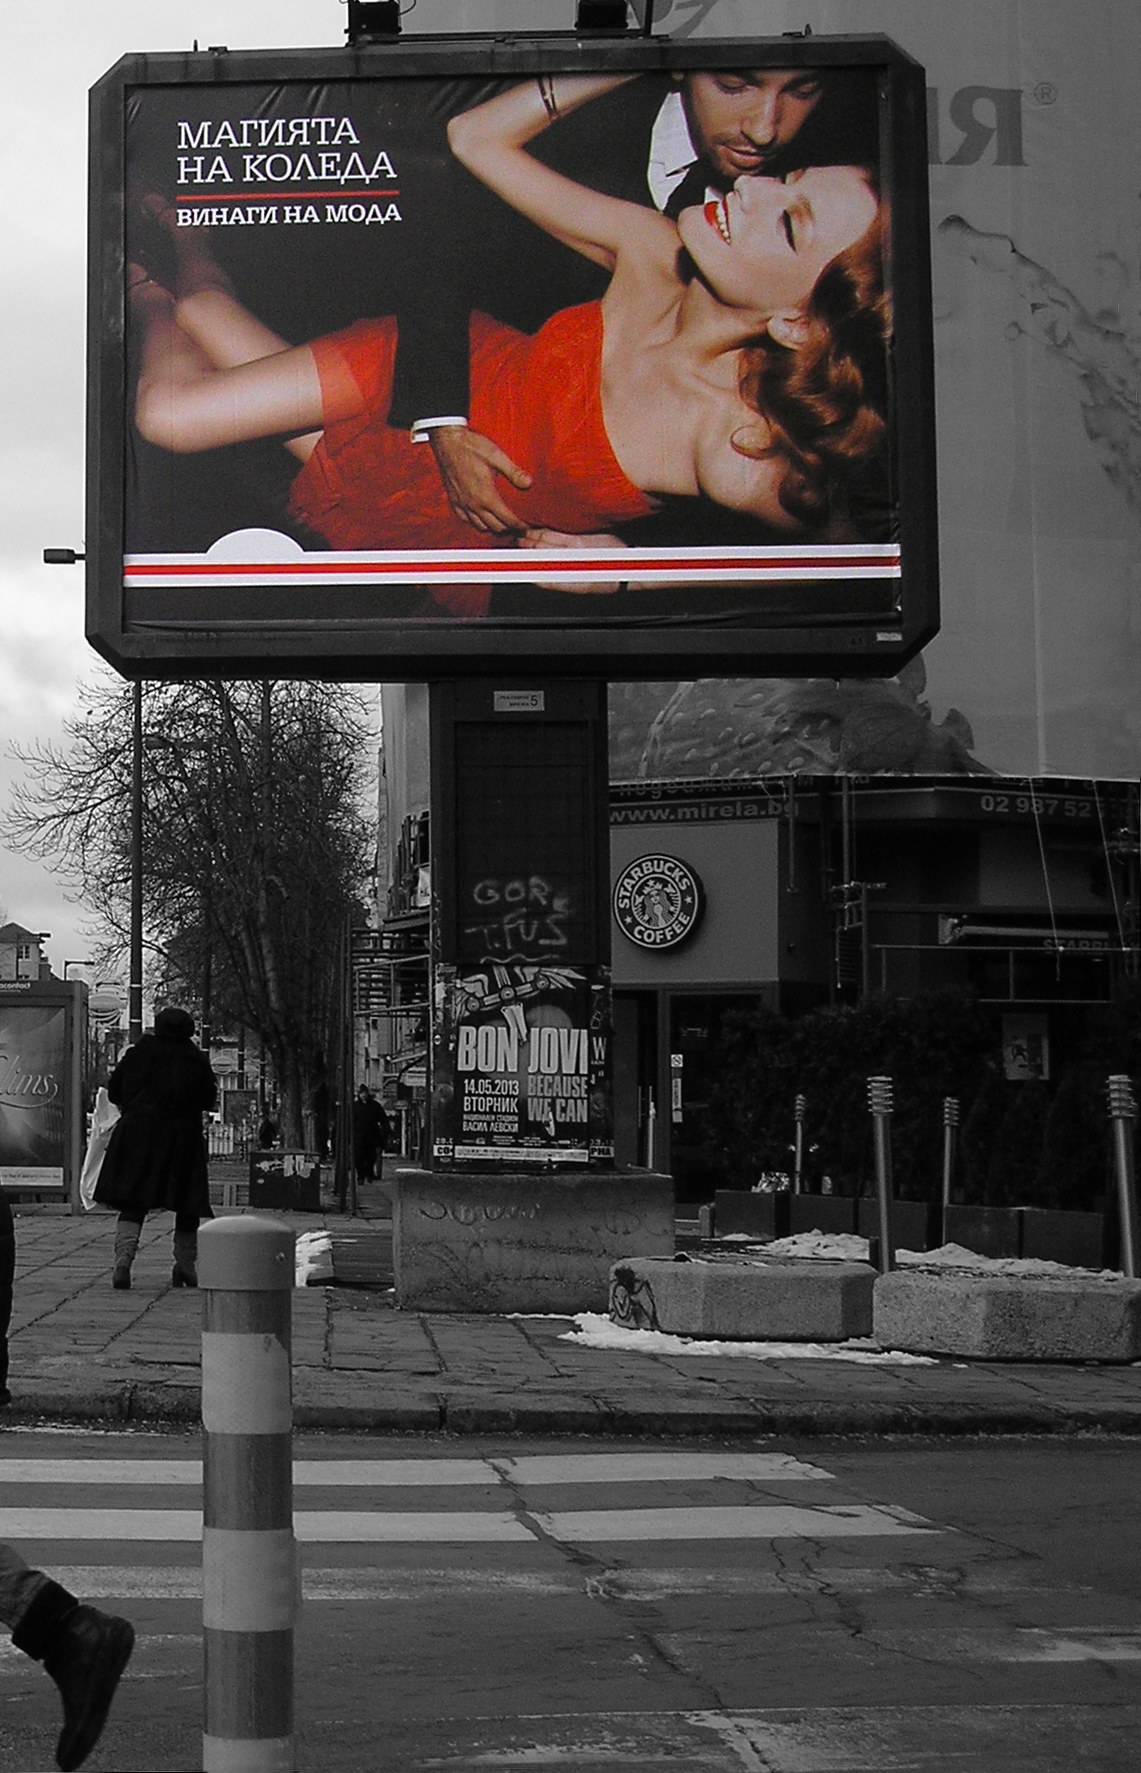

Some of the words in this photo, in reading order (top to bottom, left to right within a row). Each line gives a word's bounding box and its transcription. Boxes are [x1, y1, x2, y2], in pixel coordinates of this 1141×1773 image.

[177, 118, 360, 150] МАГИЯТА
[177, 156, 233, 184] НА
[242, 152, 397, 185] КОЛЕДА
[177, 206, 278, 226] ВИНАГИ
[283, 205, 320, 224] НА
[325, 204, 402, 225] МОДА
[530, 694, 538, 707] 5
[610, 800, 799, 822] www.mirela.bg
[980, 795, 1009, 813] 02
[1016, 797, 1058, 815] 987
[1064, 801, 1091, 817] 52
[618, 860, 691, 909] STARBUCKS
[633, 912, 690, 943] COFFEE
[457, 1026, 518, 1072] BON
[527, 1027, 588, 1074] JOVI
[464, 1079, 519, 1095] 14.05.2013
[527, 1075, 588, 1097] BECAUSE
[463, 1096, 518, 1113] ВТОРНИК
[527, 1098, 552, 1121] WE
[556, 1098, 588, 1122] CAN
[462, 1121, 488, 1132] ВАСИЛ
[490, 1122, 518, 1133] ЛЕВСКИ
